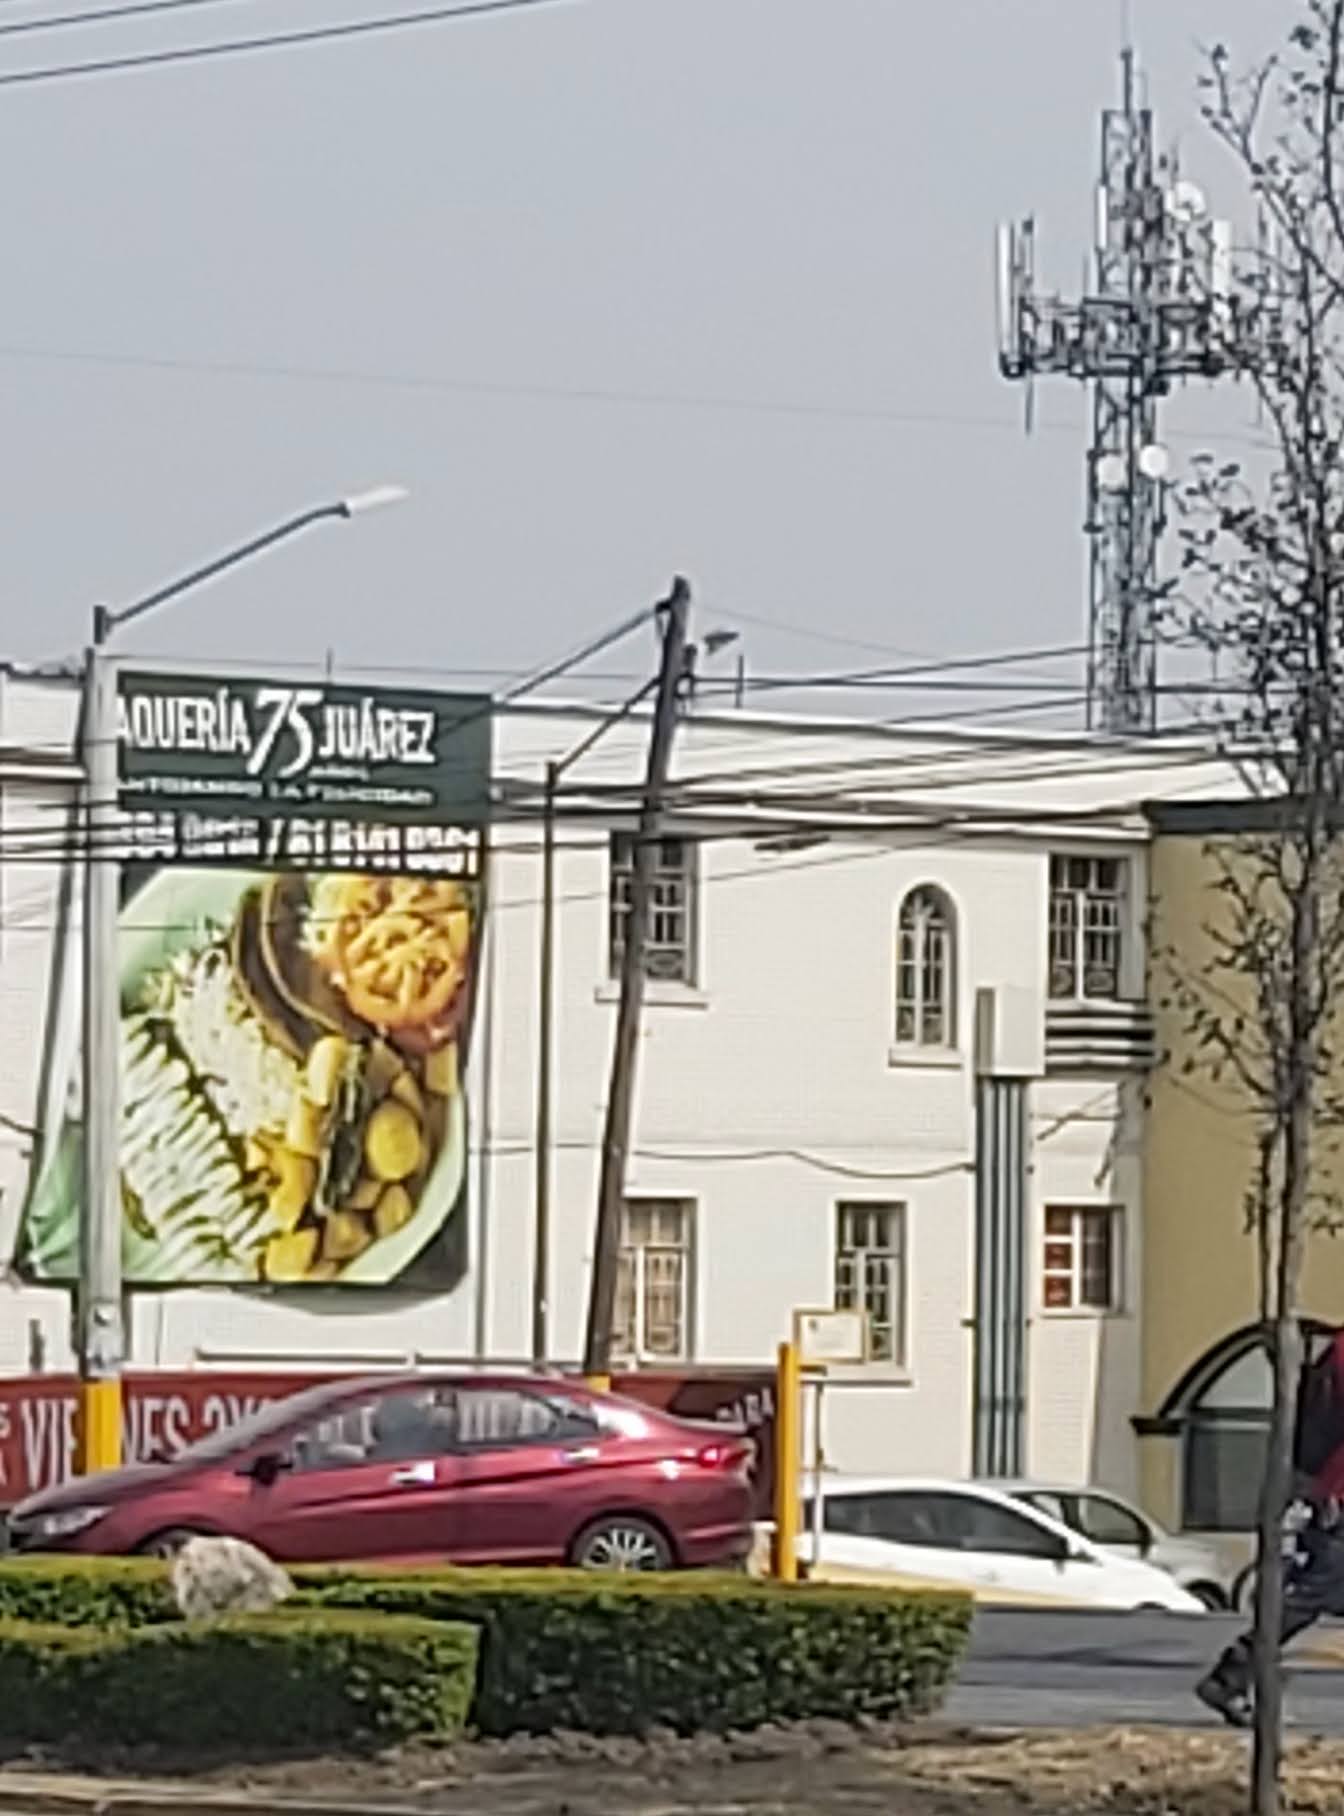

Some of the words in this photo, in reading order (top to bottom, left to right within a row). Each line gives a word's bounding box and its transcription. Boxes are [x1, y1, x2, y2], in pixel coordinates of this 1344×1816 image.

[117, 687, 252, 754] AQUERÍA
[246, 688, 324, 775] 75
[318, 697, 436, 763] JUÁREZ
[20, 1395, 191, 1490] VIENES
